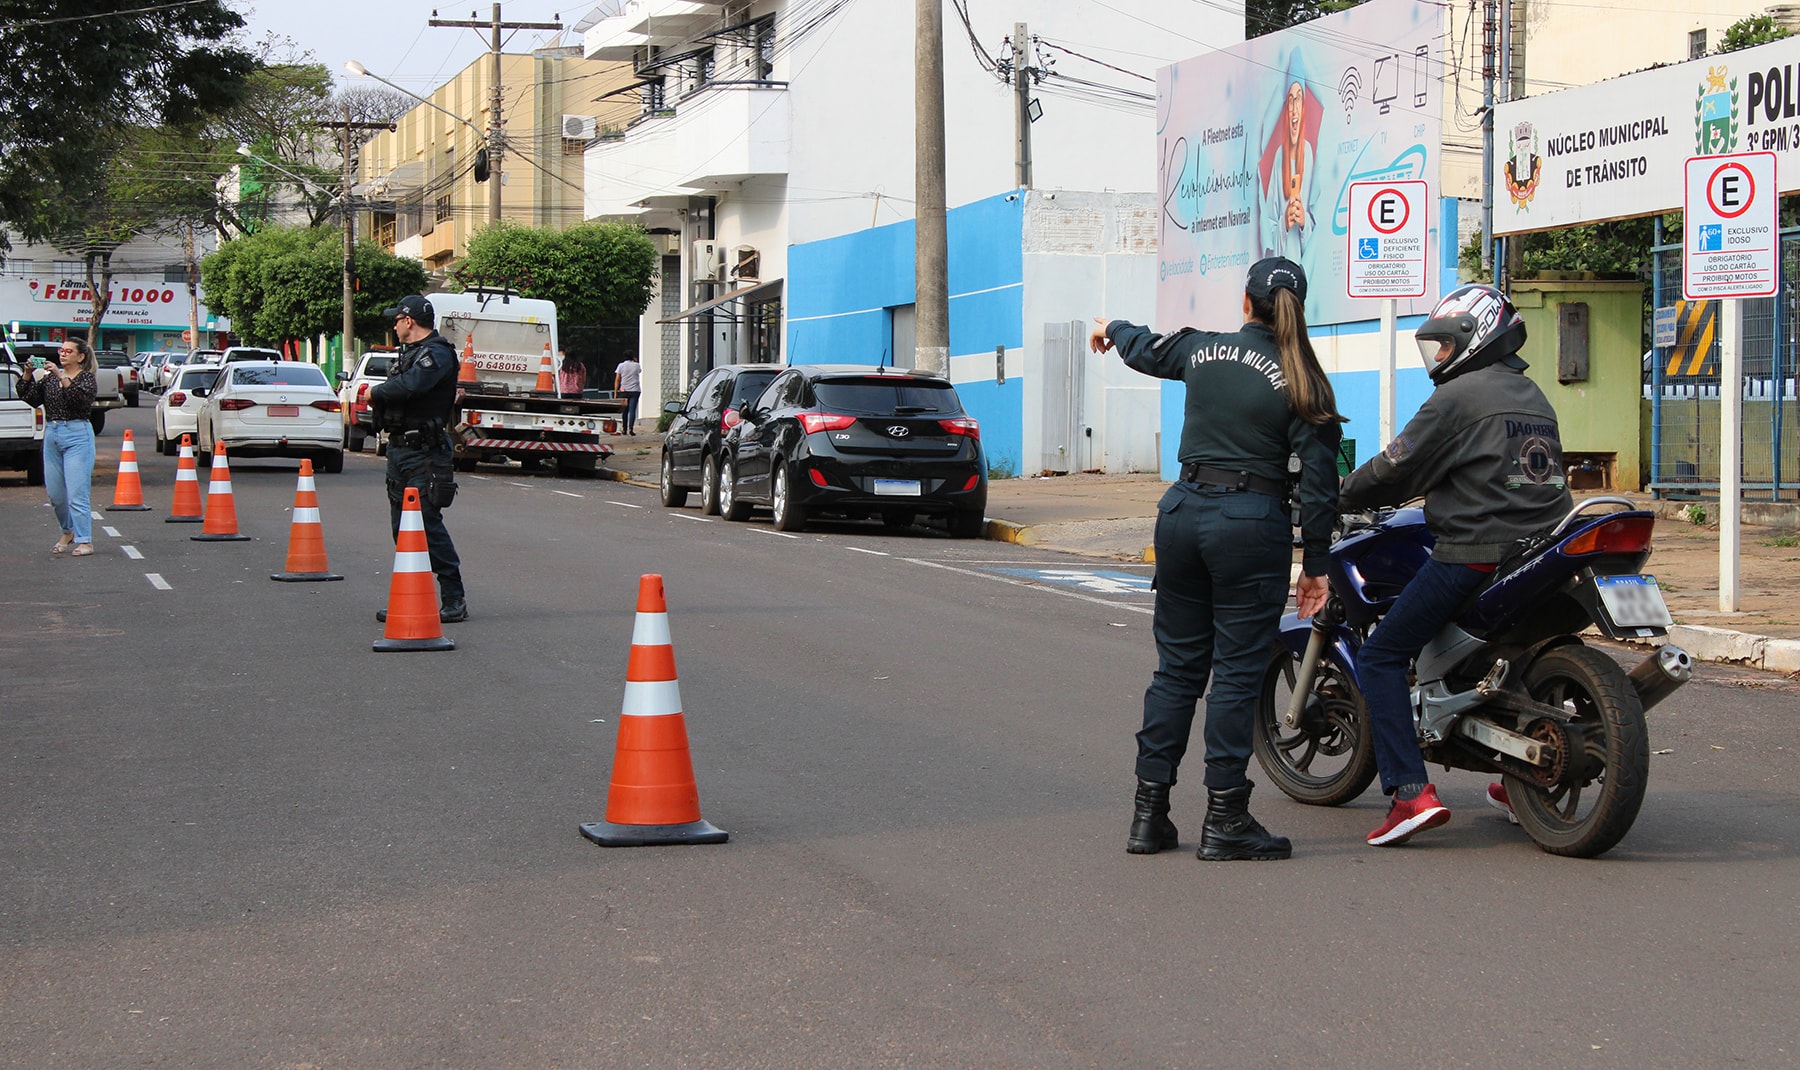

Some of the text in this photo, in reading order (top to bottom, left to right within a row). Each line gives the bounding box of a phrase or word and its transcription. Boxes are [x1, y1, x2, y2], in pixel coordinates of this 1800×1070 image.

[1202, 120, 1244, 146] A Fleetnet está
[1547, 116, 1669, 157] NÚCLEO MUNICIPAL
[1566, 156, 1647, 188] DE TRÂNSITO
[1722, 176, 1739, 207] E
[1380, 199, 1395, 224] E
[1191, 221, 1195, 234] a
[1196, 216, 1218, 233] internet
[1218, 217, 1228, 230] em
[1727, 226, 1769, 235] EXCLUSIVO
[1727, 236, 1751, 244] IDOSO
[1207, 250, 1250, 270] Entretenimento
[1708, 253, 1753, 263] OBRIGATÓRIO
[1704, 262, 1757, 272] USO DO CARTÃO
[60, 279, 99, 289] Farmáa
[1702, 272, 1758, 283] PROIBIDO MOTOS
[121, 287, 174, 303] 1000
[460, 351, 487, 359] Dque
[489, 353, 505, 361] CCR
[486, 360, 528, 372] 6480163
[1191, 342, 1289, 391] POLÍCIA MILITAR
